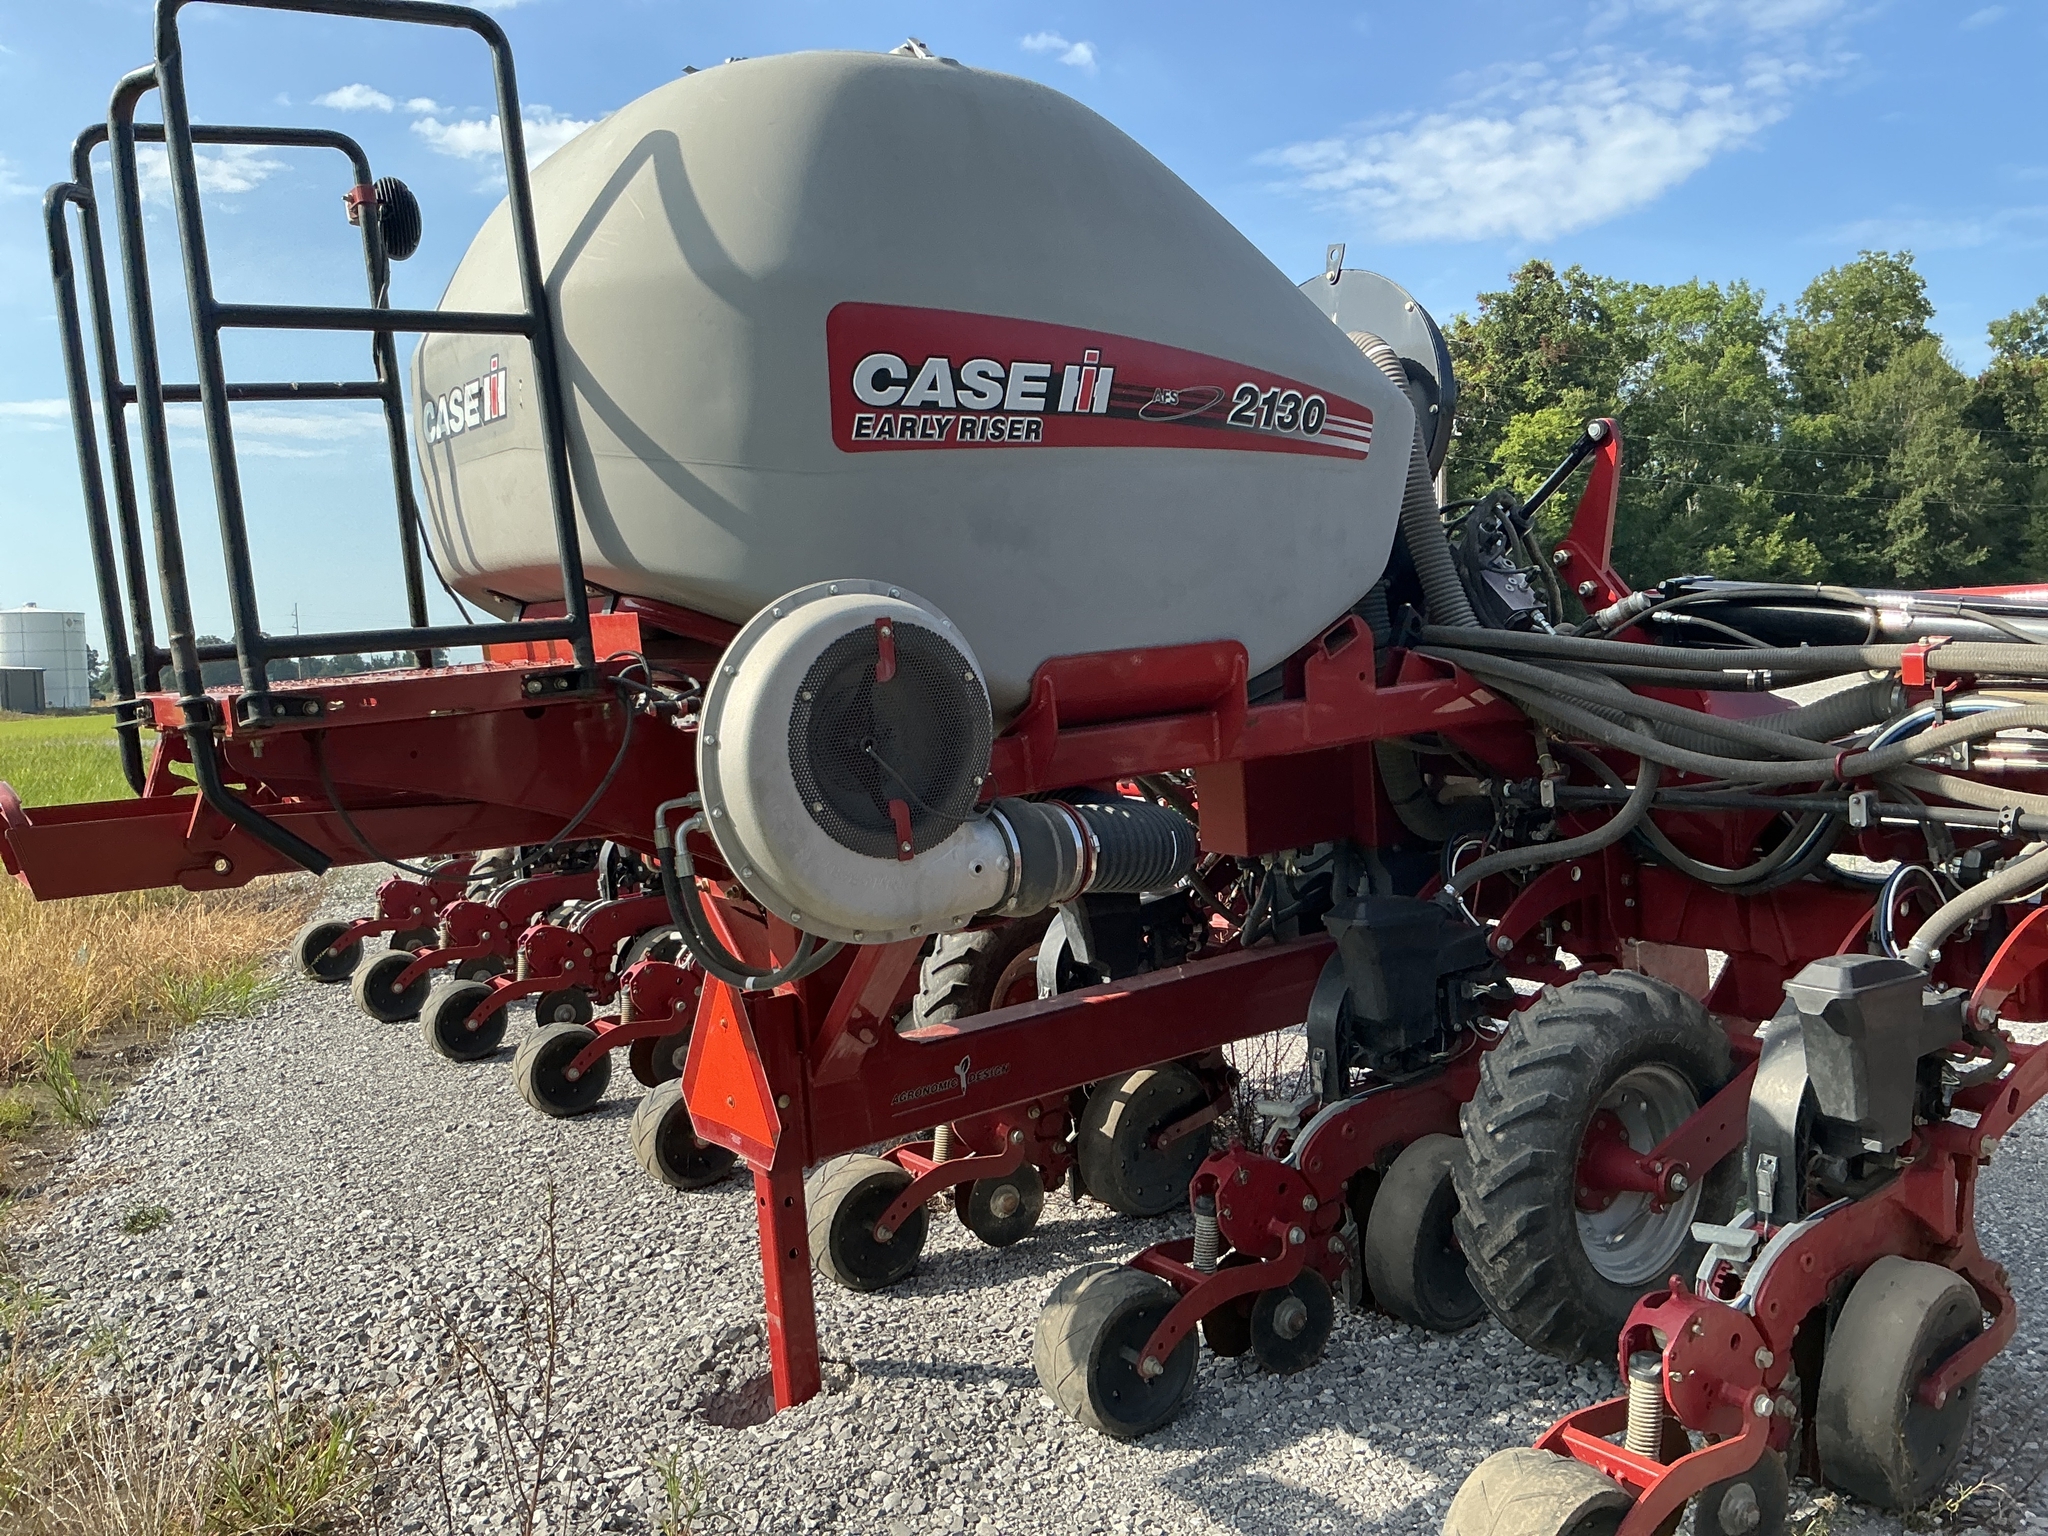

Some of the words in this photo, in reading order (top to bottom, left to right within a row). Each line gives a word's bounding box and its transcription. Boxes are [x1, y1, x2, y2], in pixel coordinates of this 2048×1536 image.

[852, 352, 1052, 411] CASE
[1152, 387, 1180, 406] AFS
[423, 378, 482, 444] CASE
[851, 413, 955, 442] EARLY
[956, 414, 1044, 443] RISER
[1226, 382, 1328, 438] 2130
[890, 1077, 958, 1105] AGRONOMIC
[967, 1062, 1011, 1085] DESIGN
